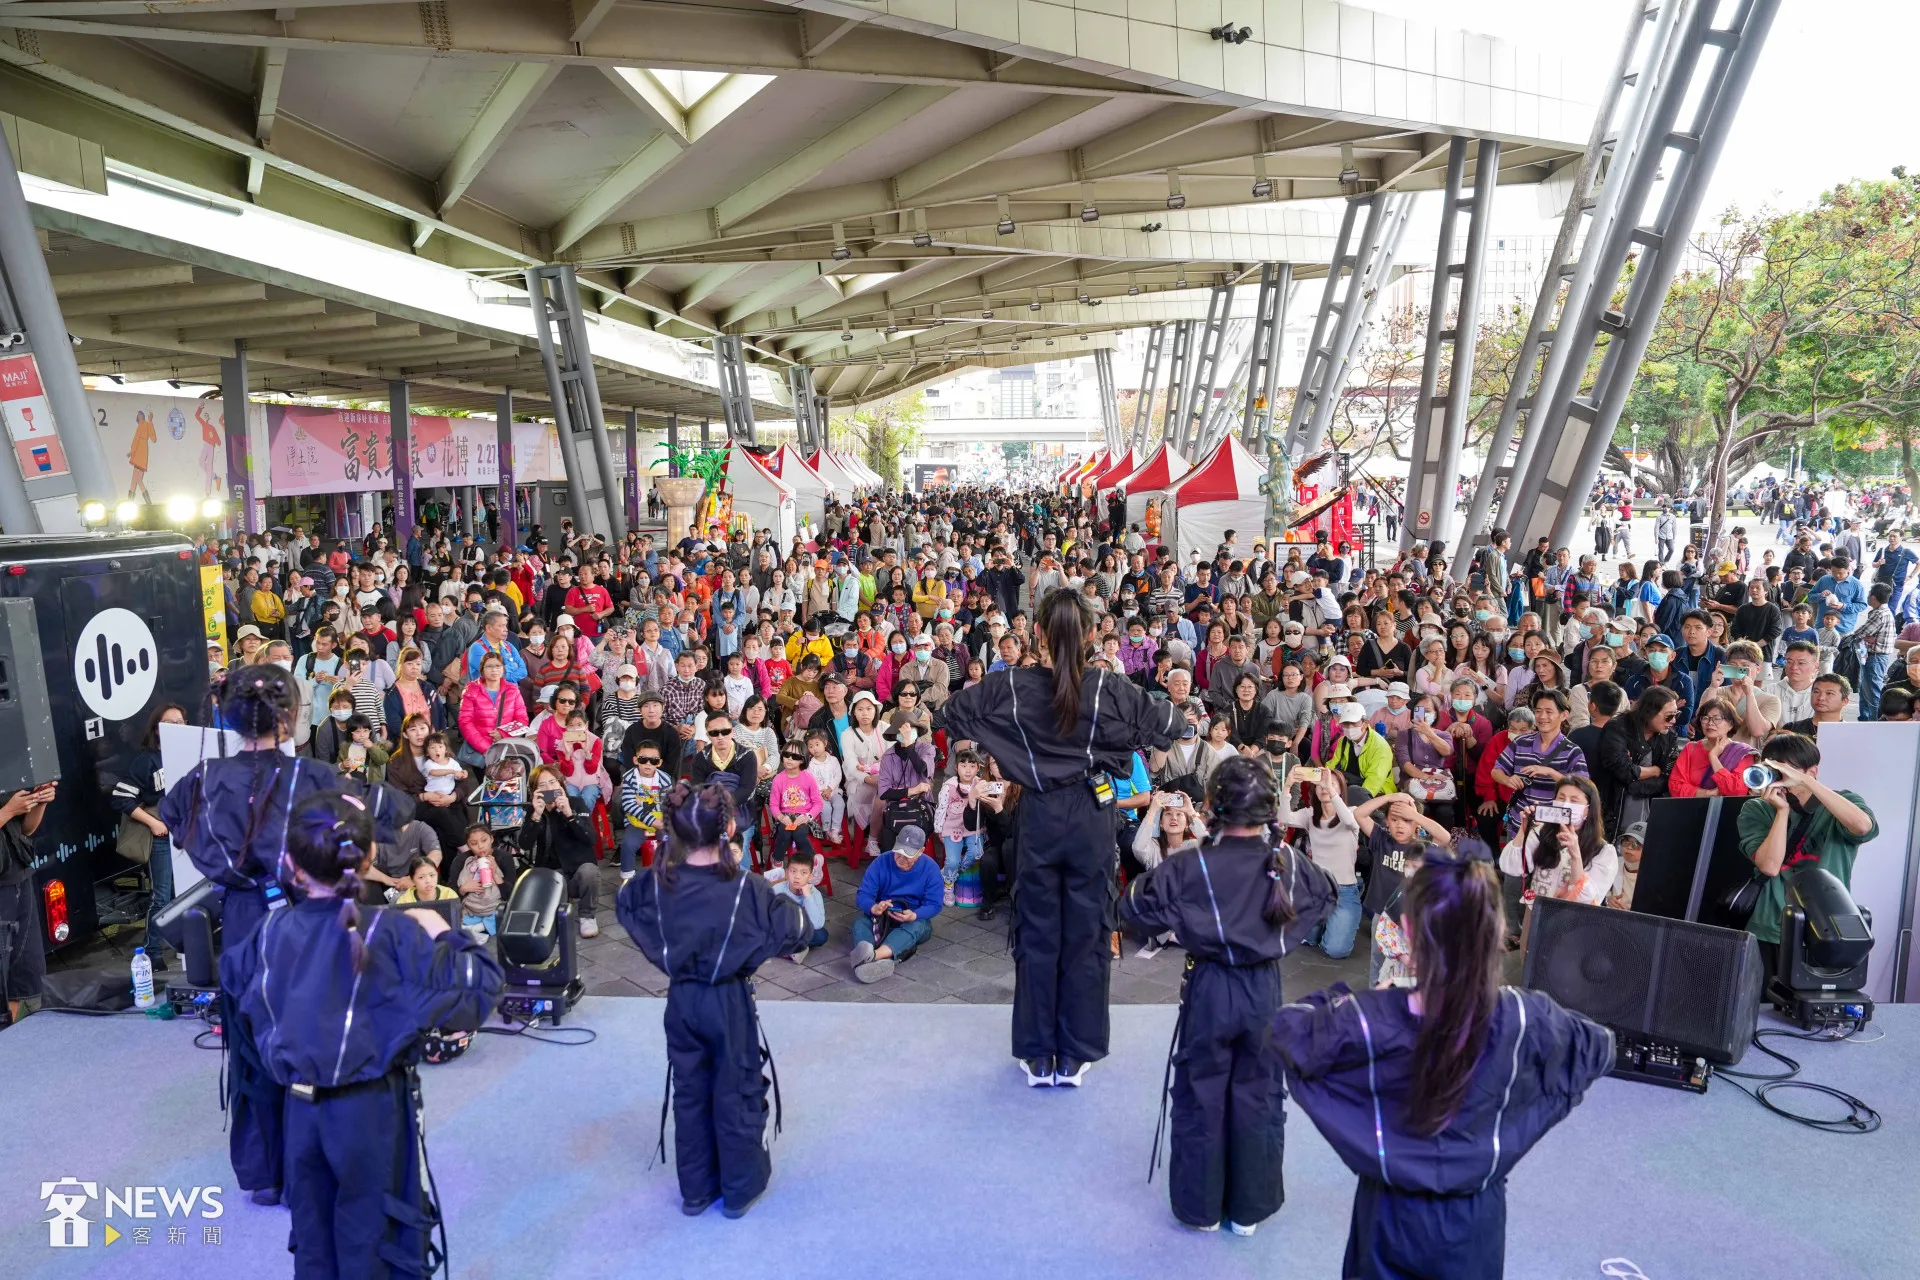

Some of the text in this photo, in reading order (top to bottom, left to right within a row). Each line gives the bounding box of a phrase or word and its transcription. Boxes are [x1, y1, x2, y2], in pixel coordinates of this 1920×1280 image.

[440, 435, 469, 477] 花博
[502, 474, 511, 512] Empower
[136, 969, 150, 978] FIN
